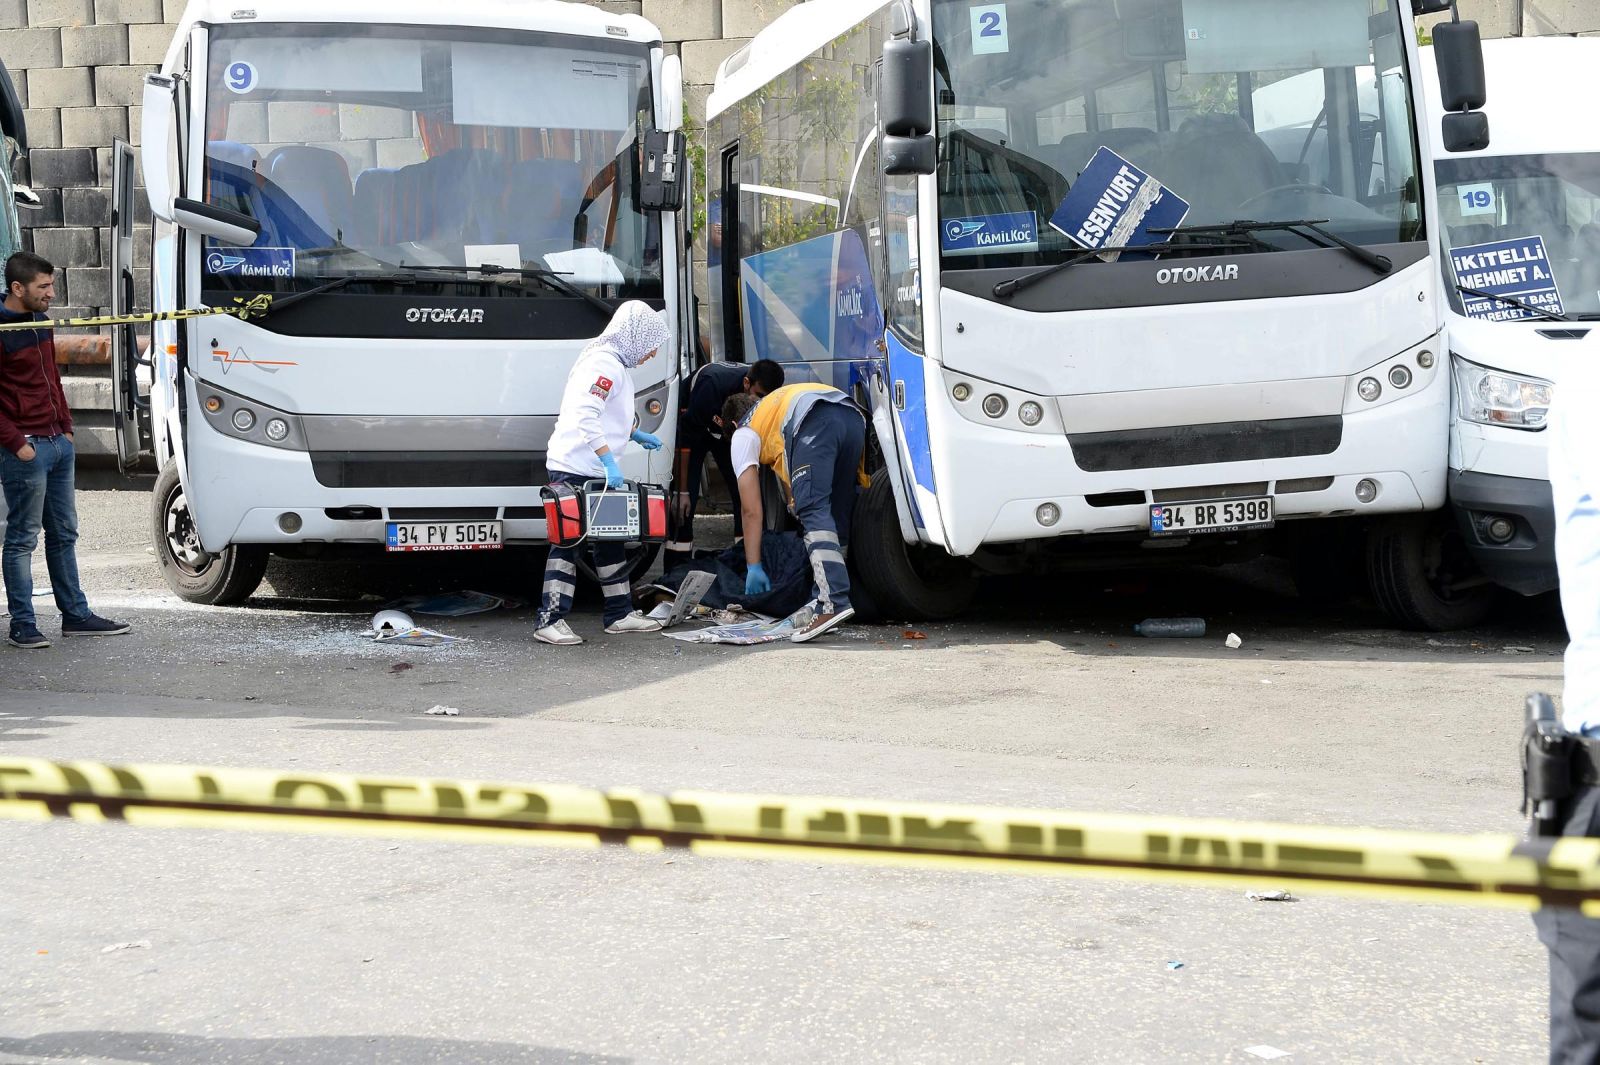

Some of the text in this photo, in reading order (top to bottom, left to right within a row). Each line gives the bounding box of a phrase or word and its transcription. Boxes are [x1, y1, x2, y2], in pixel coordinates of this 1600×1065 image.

[980, 12, 1001, 37] 2
[229, 62, 252, 90] 9
[1076, 165, 1140, 248] ESENYURT
[1463, 191, 1491, 208] 19
[1156, 264, 1239, 284] OTOKAR
[1460, 265, 1550, 290] MEHMET A.
[1466, 301, 1492, 313] HER
[1529, 293, 1559, 305] BAŞI
[405, 307, 485, 323] OTOKAR
[1162, 508, 1185, 527] 34
[1195, 505, 1217, 525] BR
[1223, 501, 1268, 523] 5398
[399, 526, 418, 544] 34
[427, 525, 448, 543] PV
[456, 525, 498, 543] 5054
